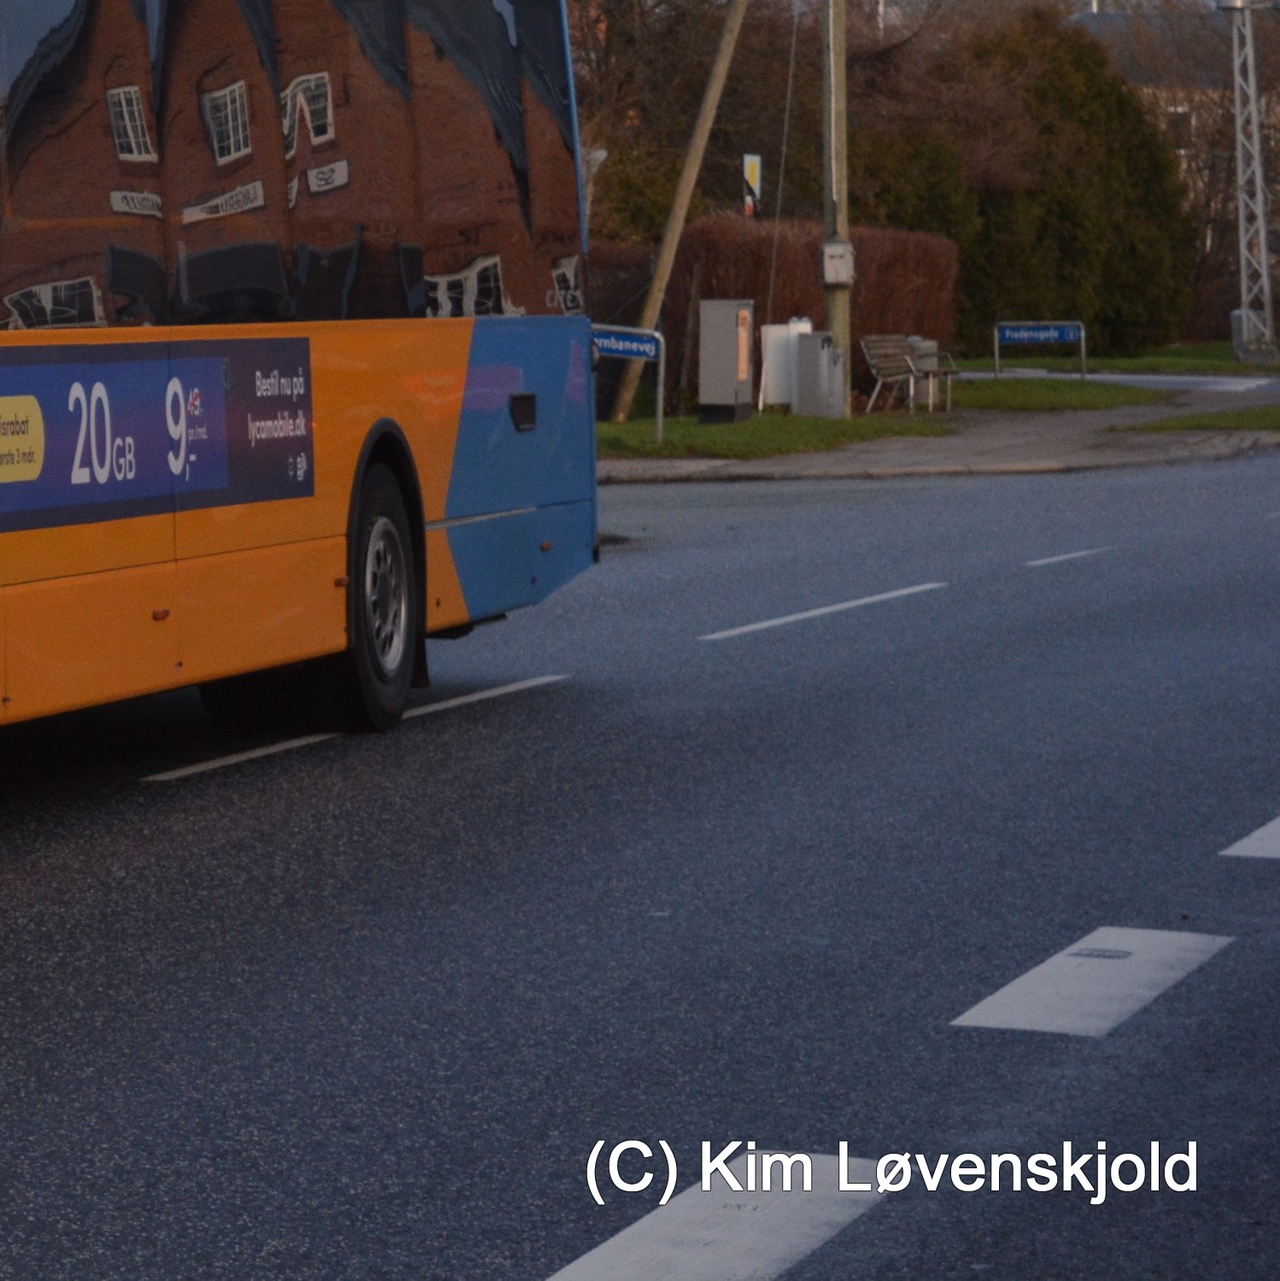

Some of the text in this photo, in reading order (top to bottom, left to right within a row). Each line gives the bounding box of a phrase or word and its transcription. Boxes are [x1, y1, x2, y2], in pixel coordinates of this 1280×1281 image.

[255, 366, 305, 403] Bestil nu på
[247, 409, 306, 448] lycamobile.dk
